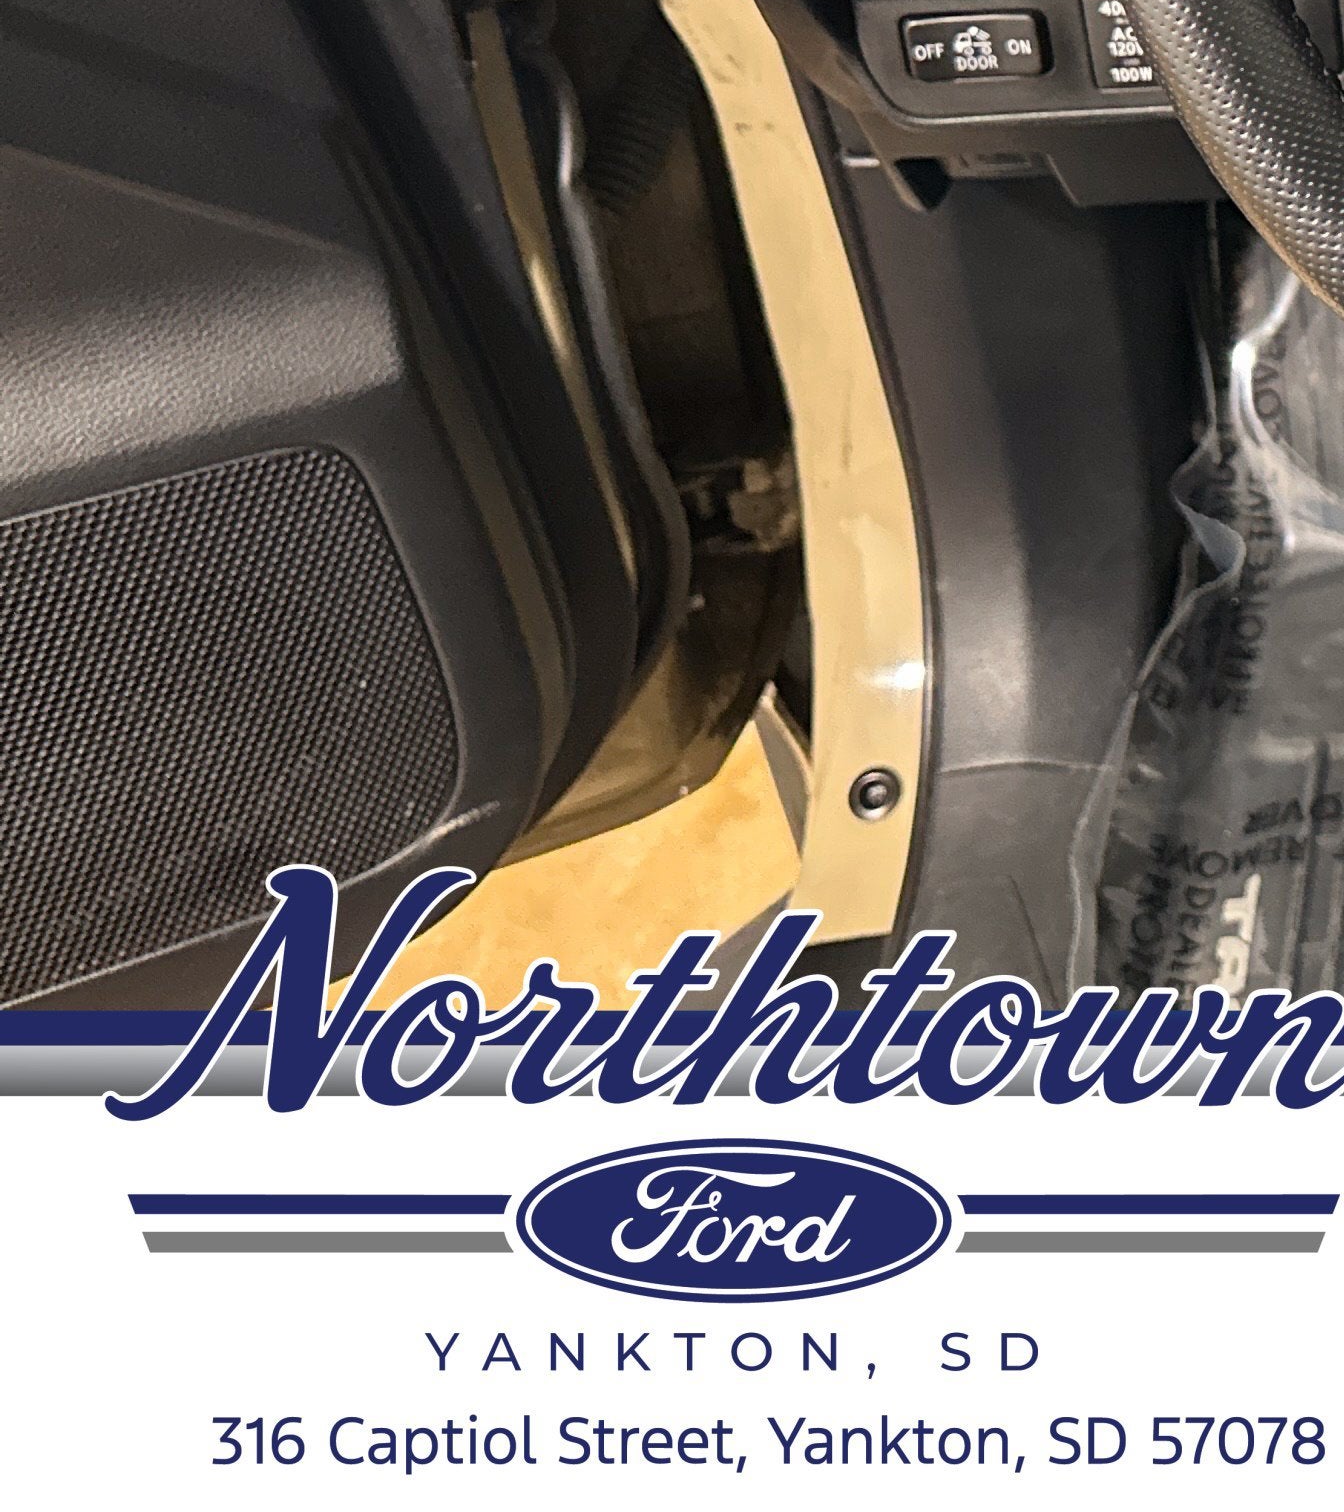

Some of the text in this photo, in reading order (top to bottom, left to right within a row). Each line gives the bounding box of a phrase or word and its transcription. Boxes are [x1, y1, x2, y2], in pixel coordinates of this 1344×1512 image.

[913, 38, 1032, 62] OFF ON
[953, 55, 999, 72] DOOR
[1110, 66, 1153, 83] 100W
